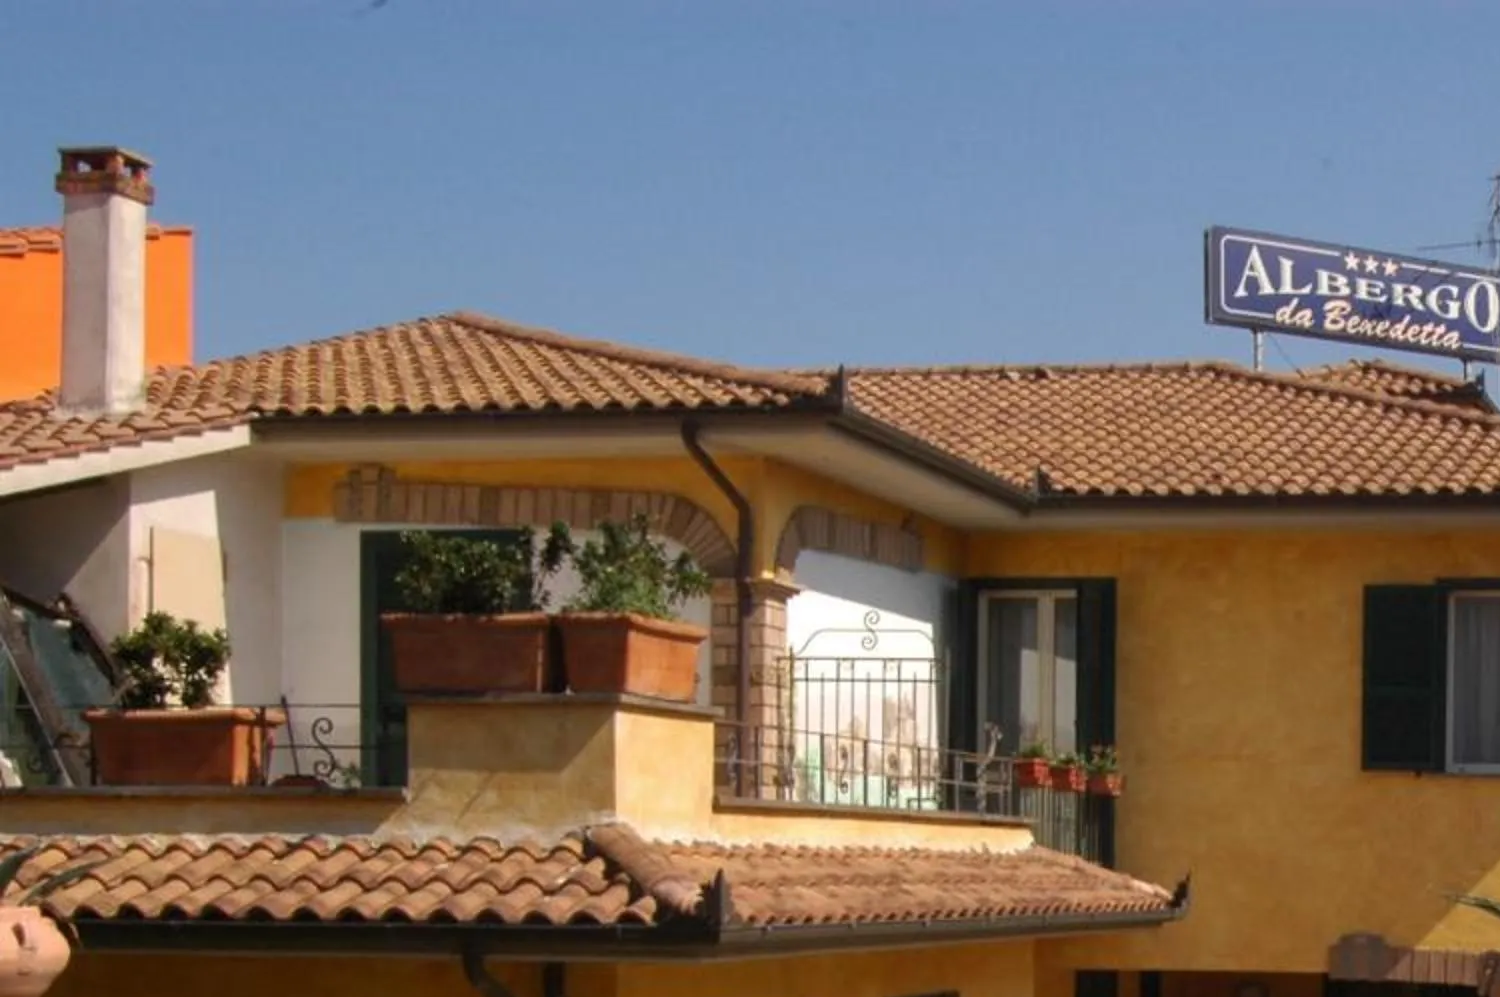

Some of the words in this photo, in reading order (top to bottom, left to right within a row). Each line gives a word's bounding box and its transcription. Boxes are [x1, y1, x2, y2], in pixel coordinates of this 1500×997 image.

[1233, 244, 1499, 333] ALBERGO
[1275, 298, 1314, 328] da
[1323, 300, 1462, 349] Benedetta
